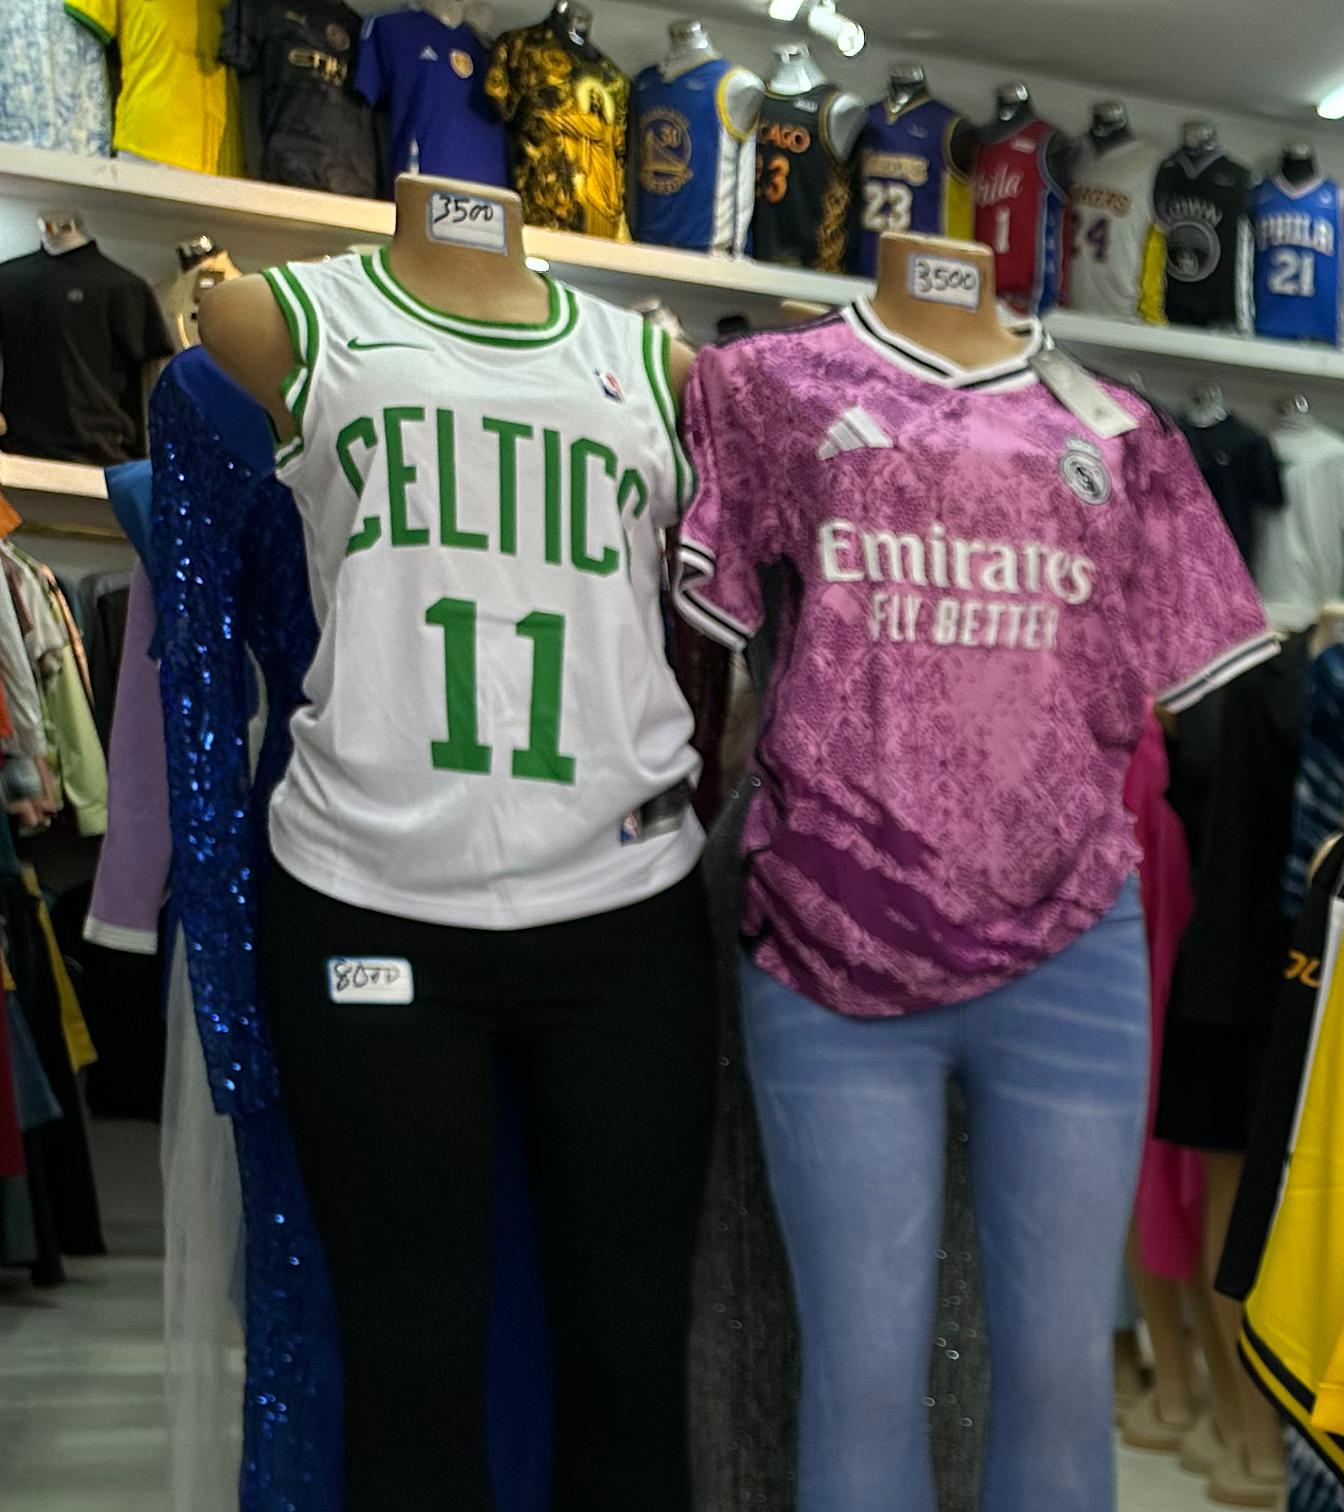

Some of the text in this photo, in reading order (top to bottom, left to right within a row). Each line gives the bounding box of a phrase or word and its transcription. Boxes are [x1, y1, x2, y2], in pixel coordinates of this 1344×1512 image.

[432, 193, 494, 224] 3500
[913, 261, 978, 292] 3500
[1267, 250, 1316, 298] 21
[819, 518, 1097, 605] Emirates
[868, 589, 923, 643] FLY
[425, 597, 577, 786] 11
